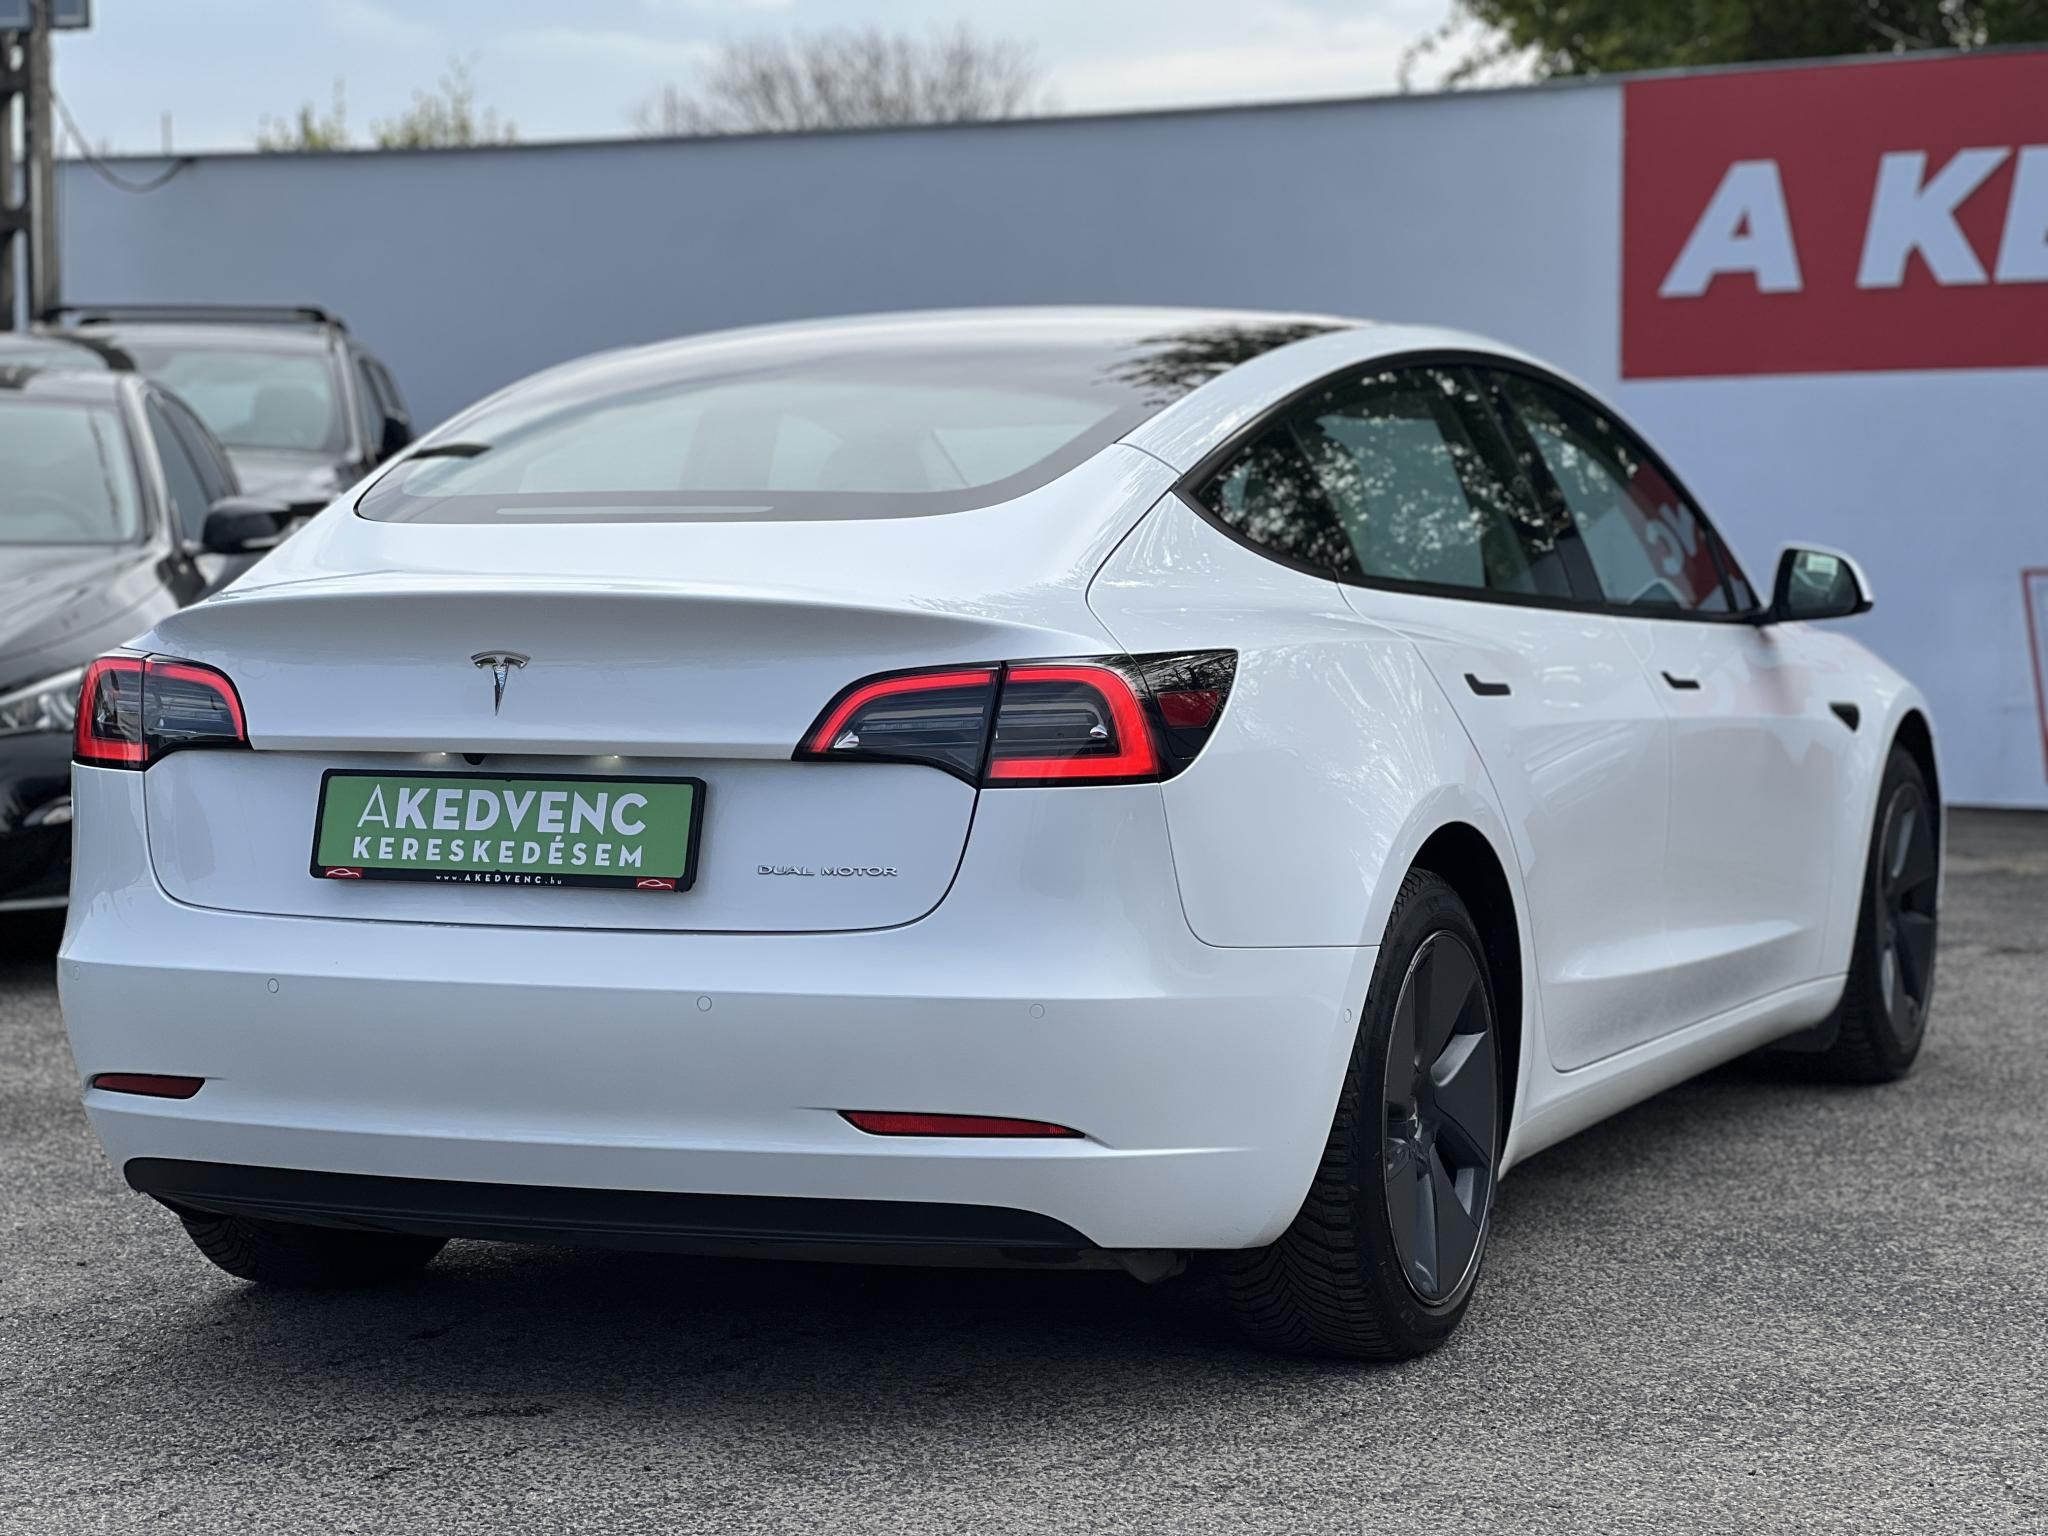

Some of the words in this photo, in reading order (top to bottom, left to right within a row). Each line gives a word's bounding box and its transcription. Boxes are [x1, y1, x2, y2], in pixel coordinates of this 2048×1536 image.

[1659, 160, 1803, 297] A
[352, 835, 643, 868] KERESKEDÉSEM
[435, 873, 562, 885] www.AKEDVENC.hu
[757, 865, 815, 876] DUAL
[821, 866, 898, 877] MOTOR
